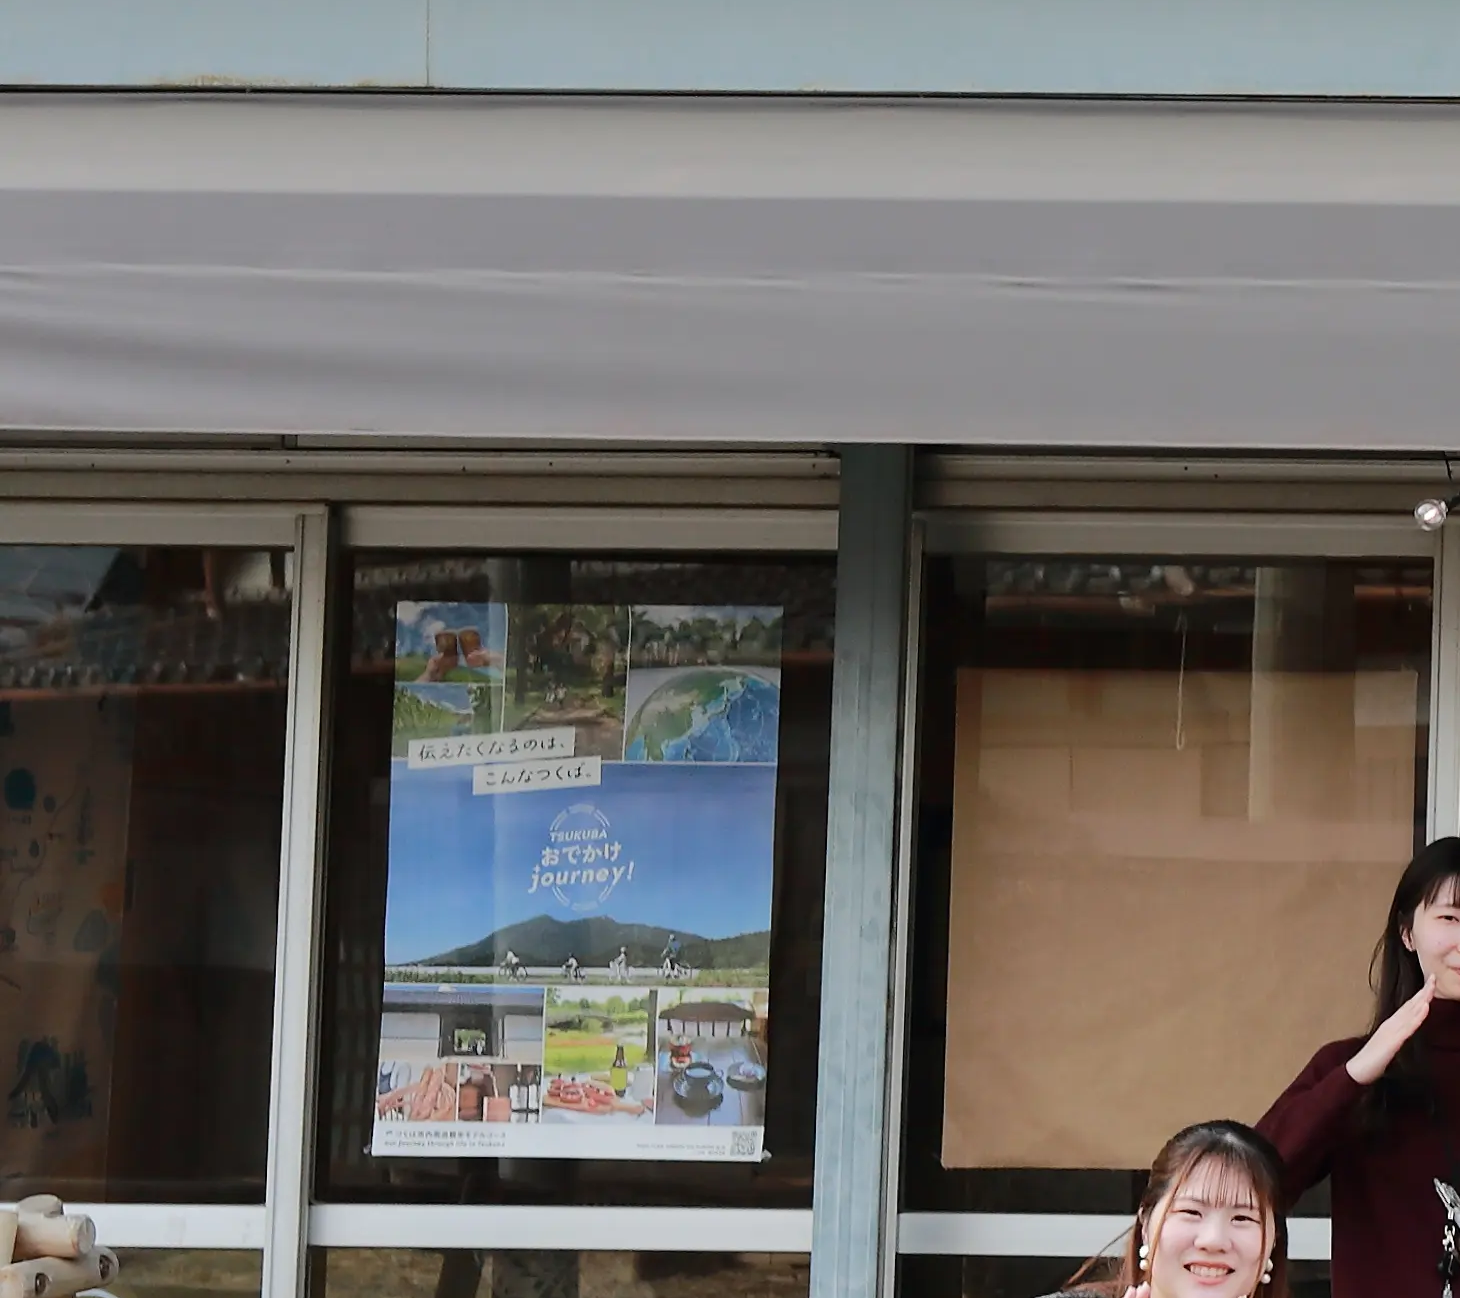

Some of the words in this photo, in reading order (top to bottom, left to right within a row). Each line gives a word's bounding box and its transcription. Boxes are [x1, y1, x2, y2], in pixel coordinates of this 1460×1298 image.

[418, 736, 567, 761] 伝えたくなるのは、
[485, 763, 592, 786] こんなつくば。
[549, 829, 608, 843] TSUKUBA
[541, 841, 622, 867] おでかけ
[527, 861, 635, 894] journey!
